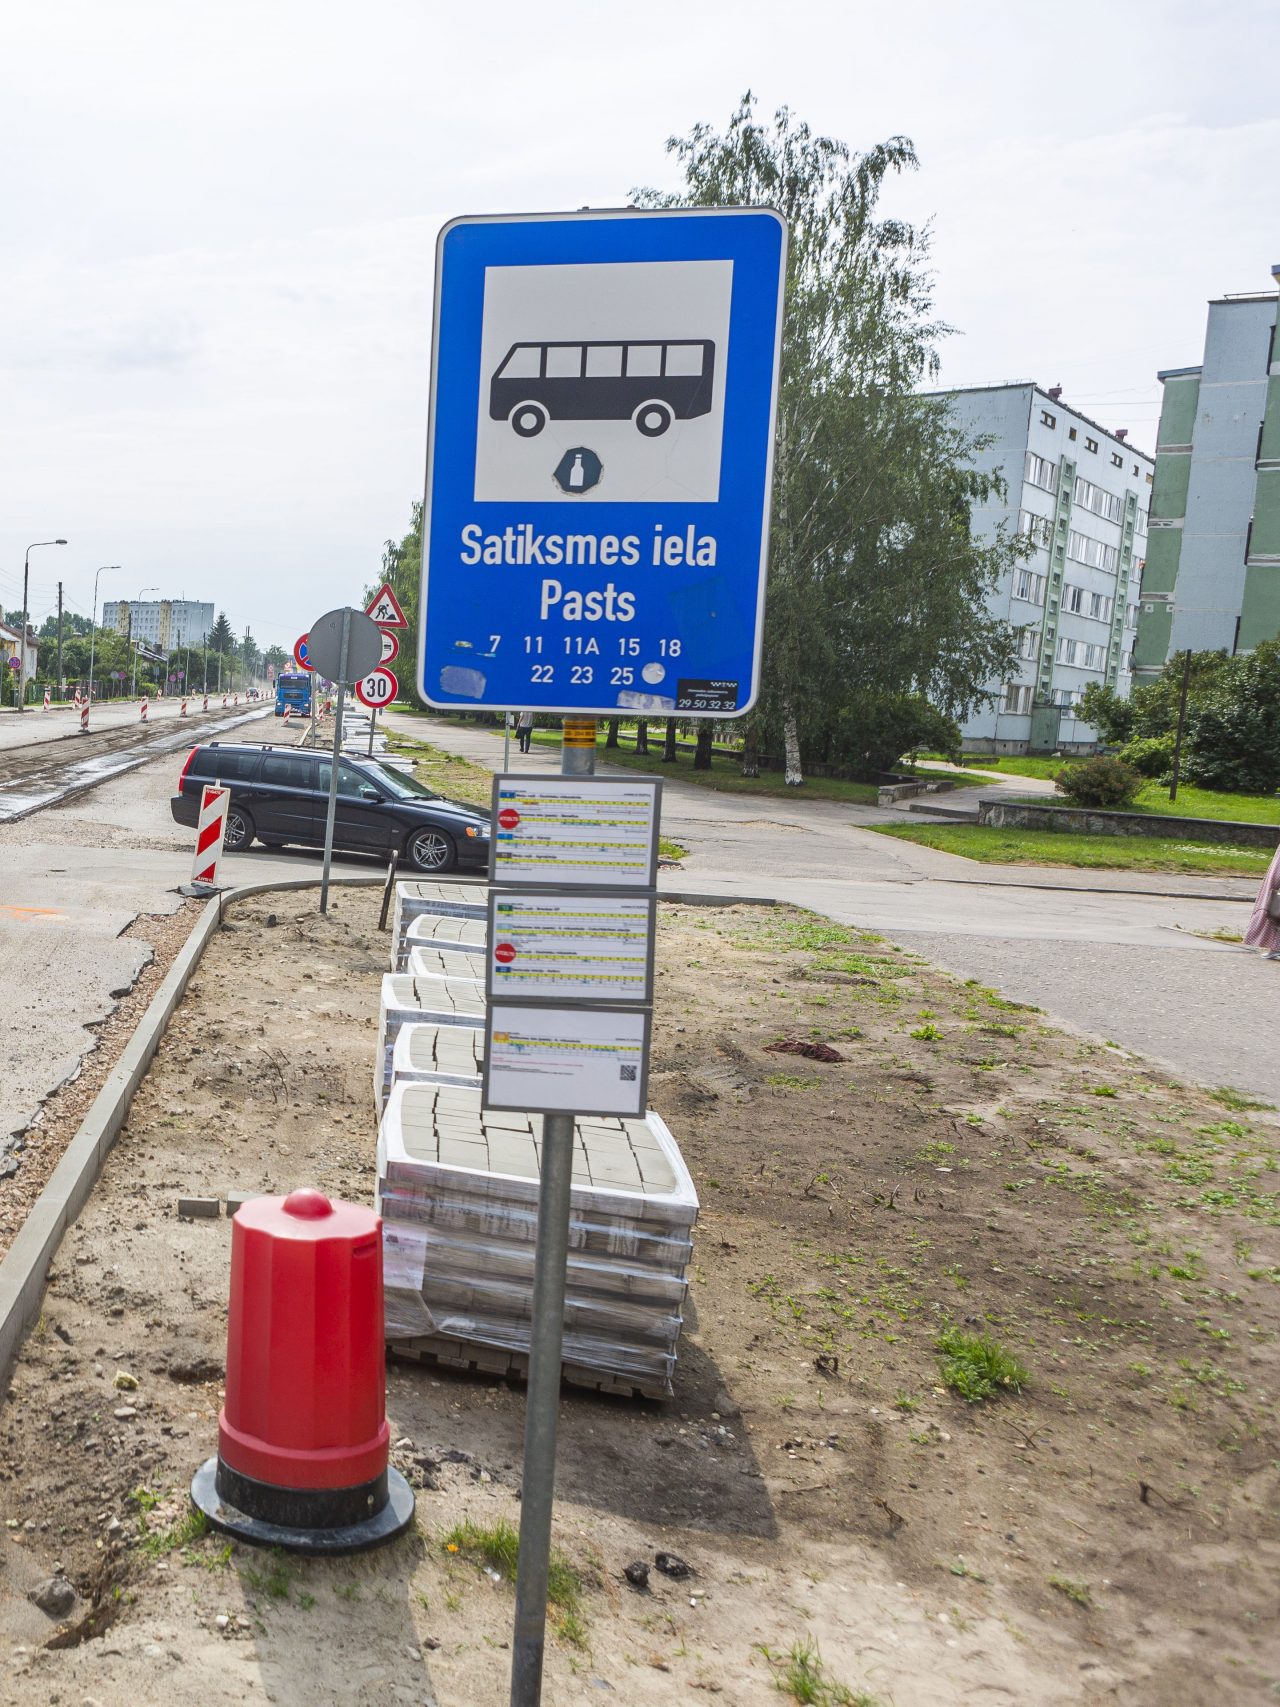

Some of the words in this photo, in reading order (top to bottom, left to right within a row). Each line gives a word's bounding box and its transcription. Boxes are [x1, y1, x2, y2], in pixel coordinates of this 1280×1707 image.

[461, 524, 640, 565] Satiksmes
[653, 525, 716, 566] iela
[541, 580, 635, 621] Pasts
[490, 636, 500, 651] 7
[525, 637, 541, 653] 11
[565, 637, 599, 654] 11A
[620, 639, 639, 655] 15
[660, 640, 680, 656] 18
[531, 665, 553, 682] 22
[571, 666, 592, 683] 23
[611, 668, 633, 684] 25
[366, 678, 387, 698] 30
[678, 699, 692, 709] 29
[692, 699, 707, 709] 50
[707, 700, 721, 709] 32
[721, 701, 736, 710] 32
